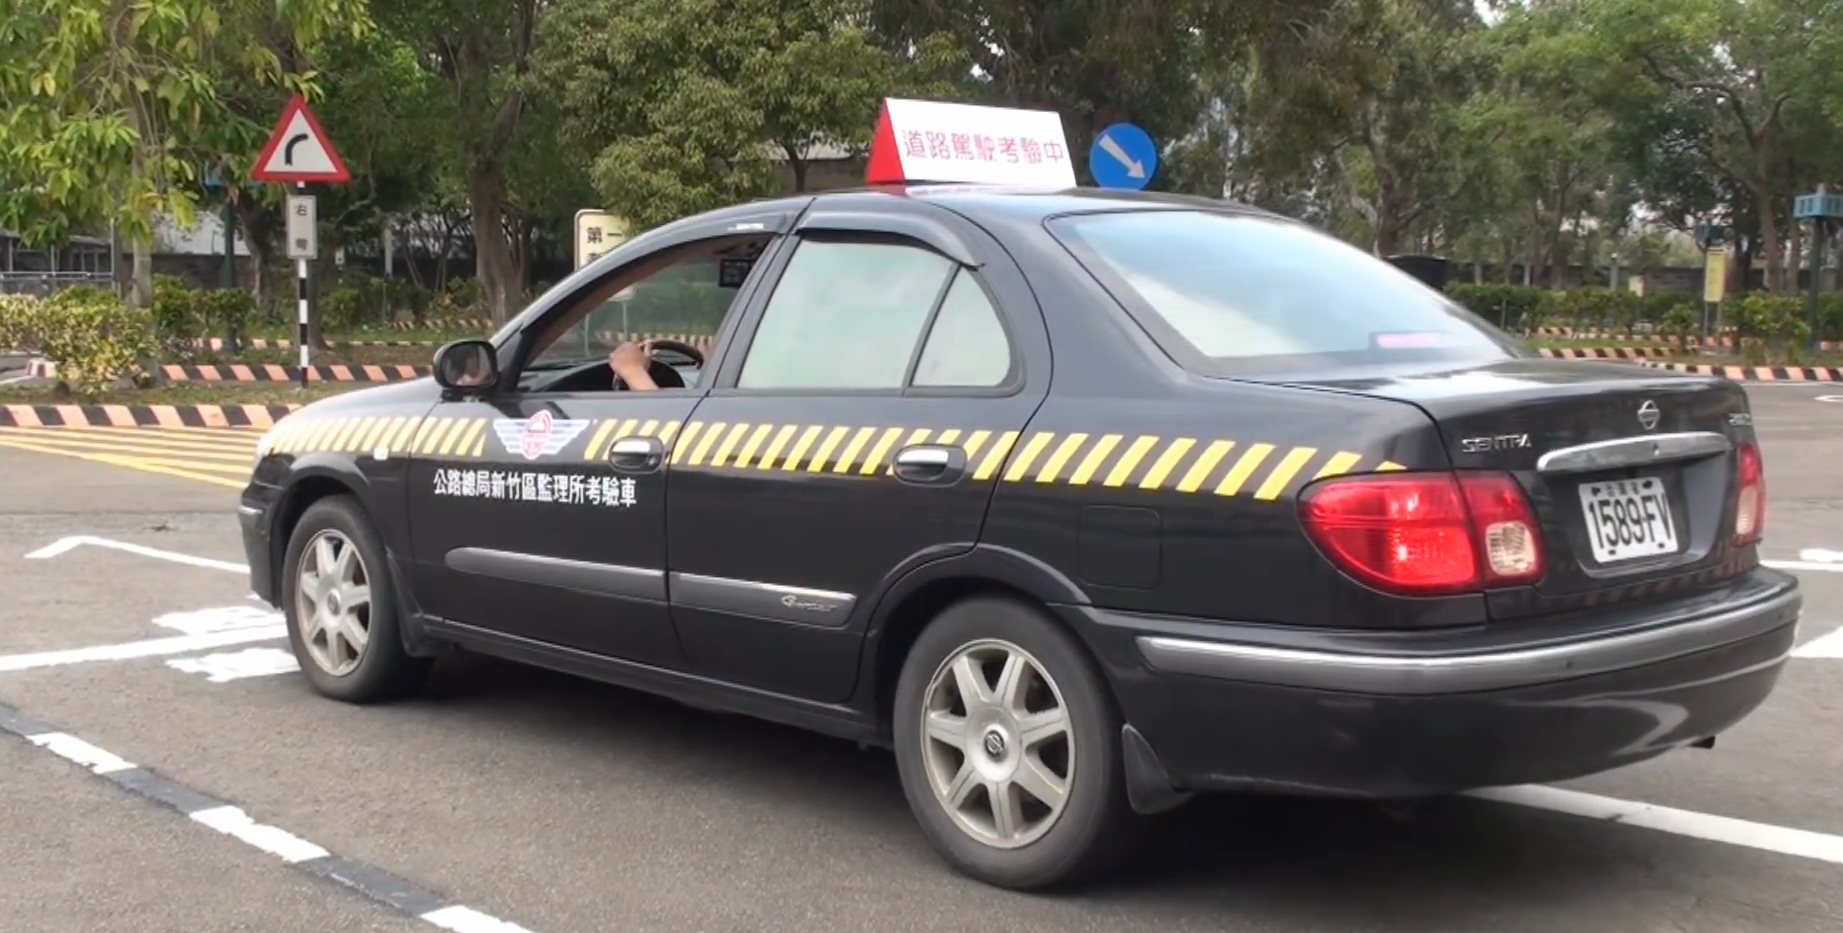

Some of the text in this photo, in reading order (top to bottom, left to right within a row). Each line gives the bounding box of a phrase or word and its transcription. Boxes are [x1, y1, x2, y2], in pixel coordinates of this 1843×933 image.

[902, 129, 1064, 164] 道路駕駛考驗中
[433, 468, 637, 508] 公路總局新竹區監理所考驗車
